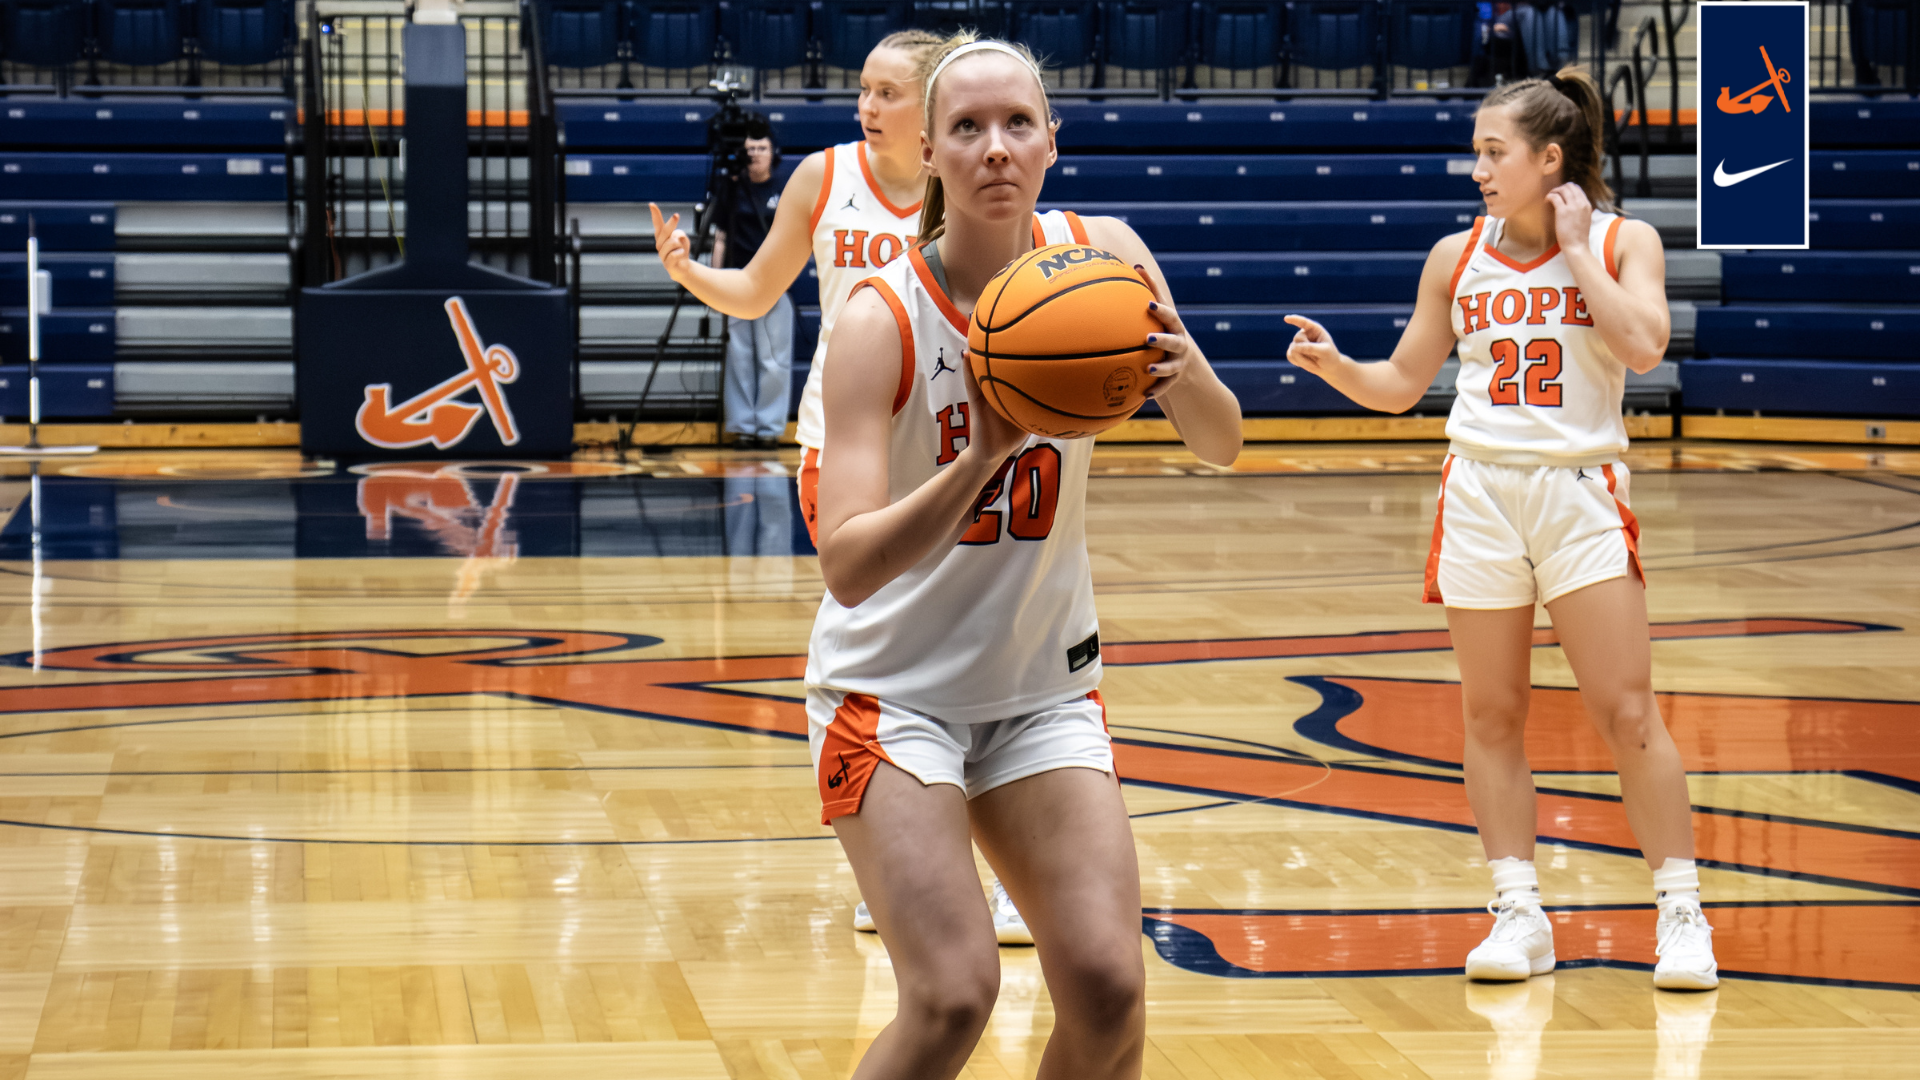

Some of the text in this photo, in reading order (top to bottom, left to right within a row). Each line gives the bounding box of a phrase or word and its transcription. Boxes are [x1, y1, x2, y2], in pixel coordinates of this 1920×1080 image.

[833, 229, 919, 269] HO
[1035, 247, 1125, 279] NCAA
[1457, 286, 1594, 335] HOPE
[1488, 338, 1563, 408] 22
[957, 443, 1062, 546] 20
